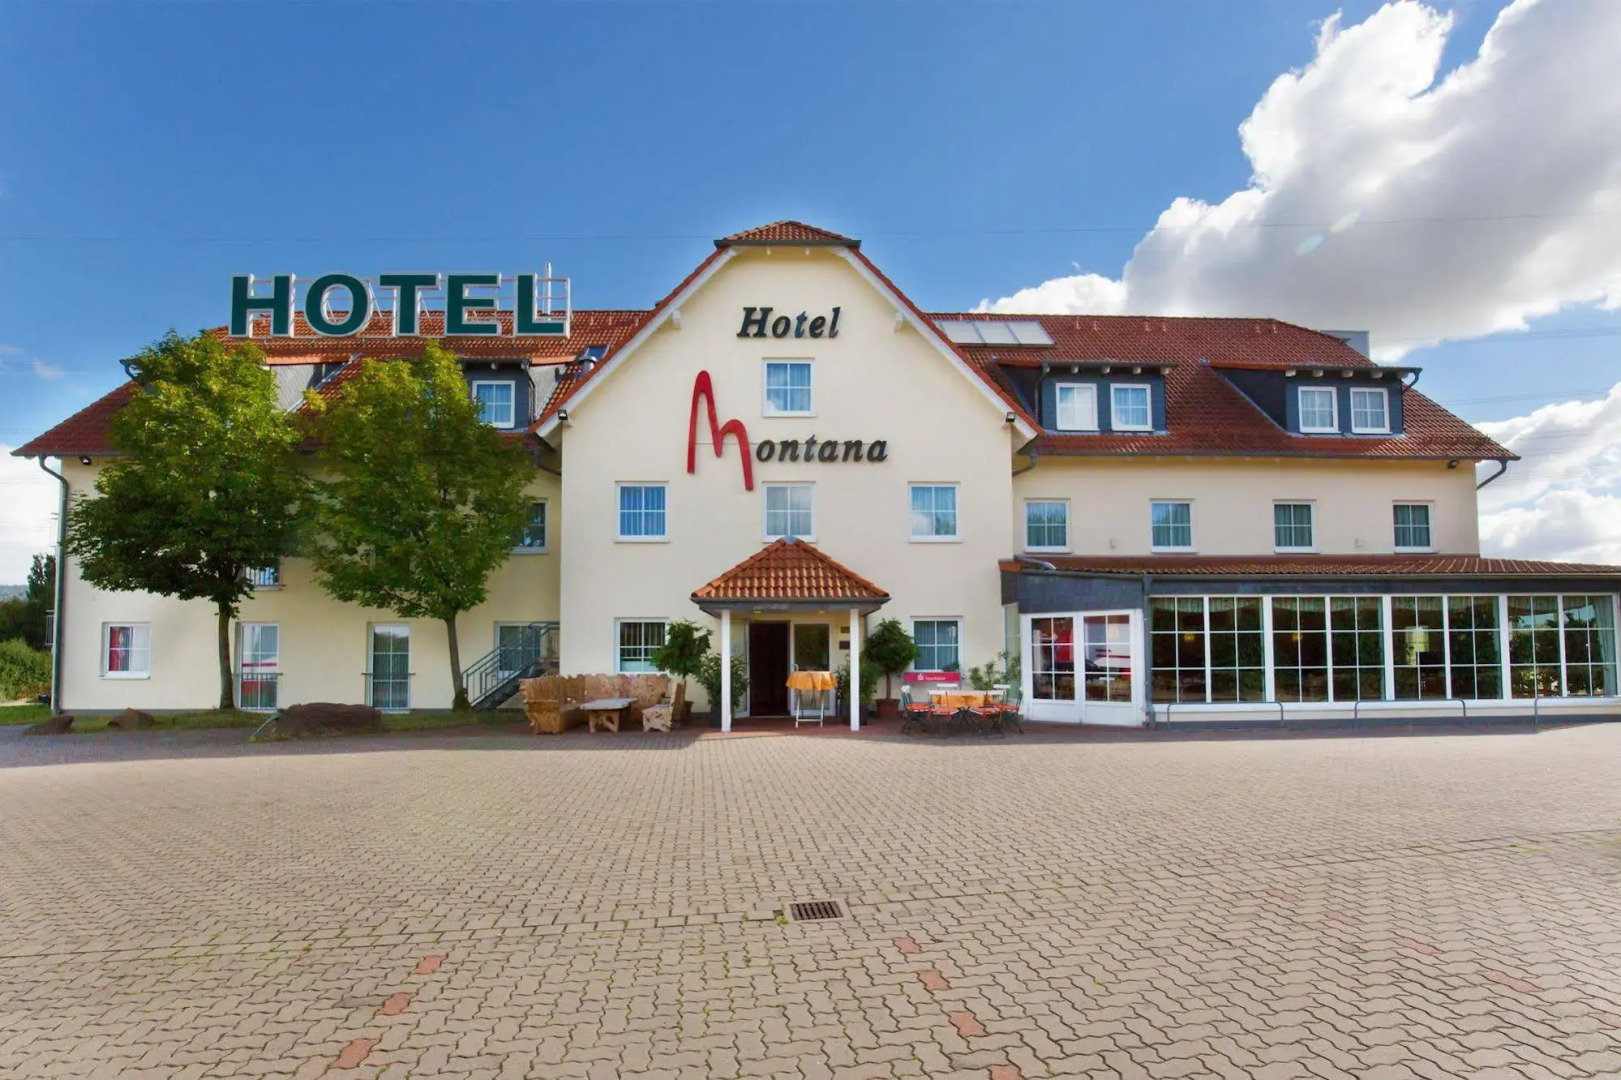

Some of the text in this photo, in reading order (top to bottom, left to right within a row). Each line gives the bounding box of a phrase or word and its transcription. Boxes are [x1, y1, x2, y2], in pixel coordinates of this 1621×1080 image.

[229, 272, 570, 338] HOTEL
[736, 306, 841, 339] Hotel
[687, 370, 888, 490] Montana
